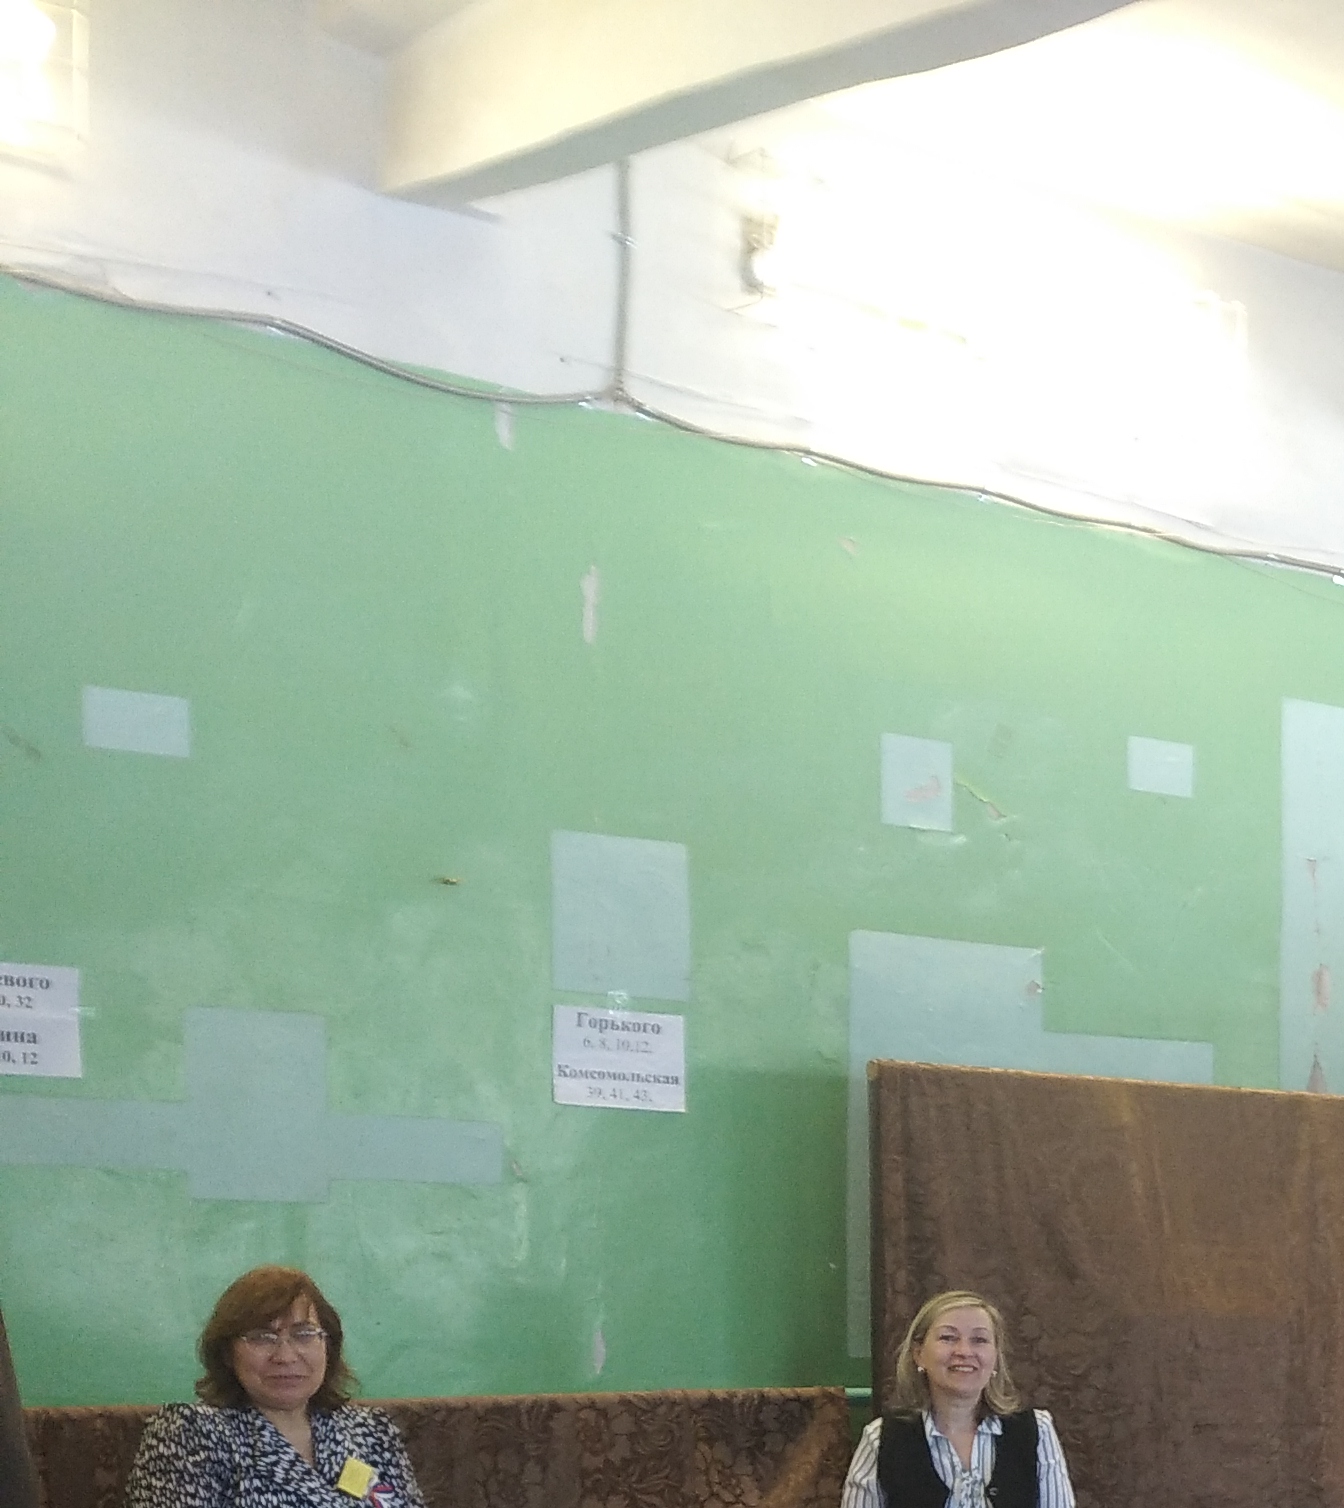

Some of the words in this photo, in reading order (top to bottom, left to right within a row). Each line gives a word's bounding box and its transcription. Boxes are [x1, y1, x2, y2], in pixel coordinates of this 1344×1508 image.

[0, 974, 50, 990] вого
[16, 995, 33, 1010] 32
[576, 1012, 661, 1035] Горького
[0, 1031, 37, 1044] ина
[2, 1050, 16, 1064] 0,
[21, 1052, 38, 1065] 12
[557, 1064, 680, 1086] Комсомольская
